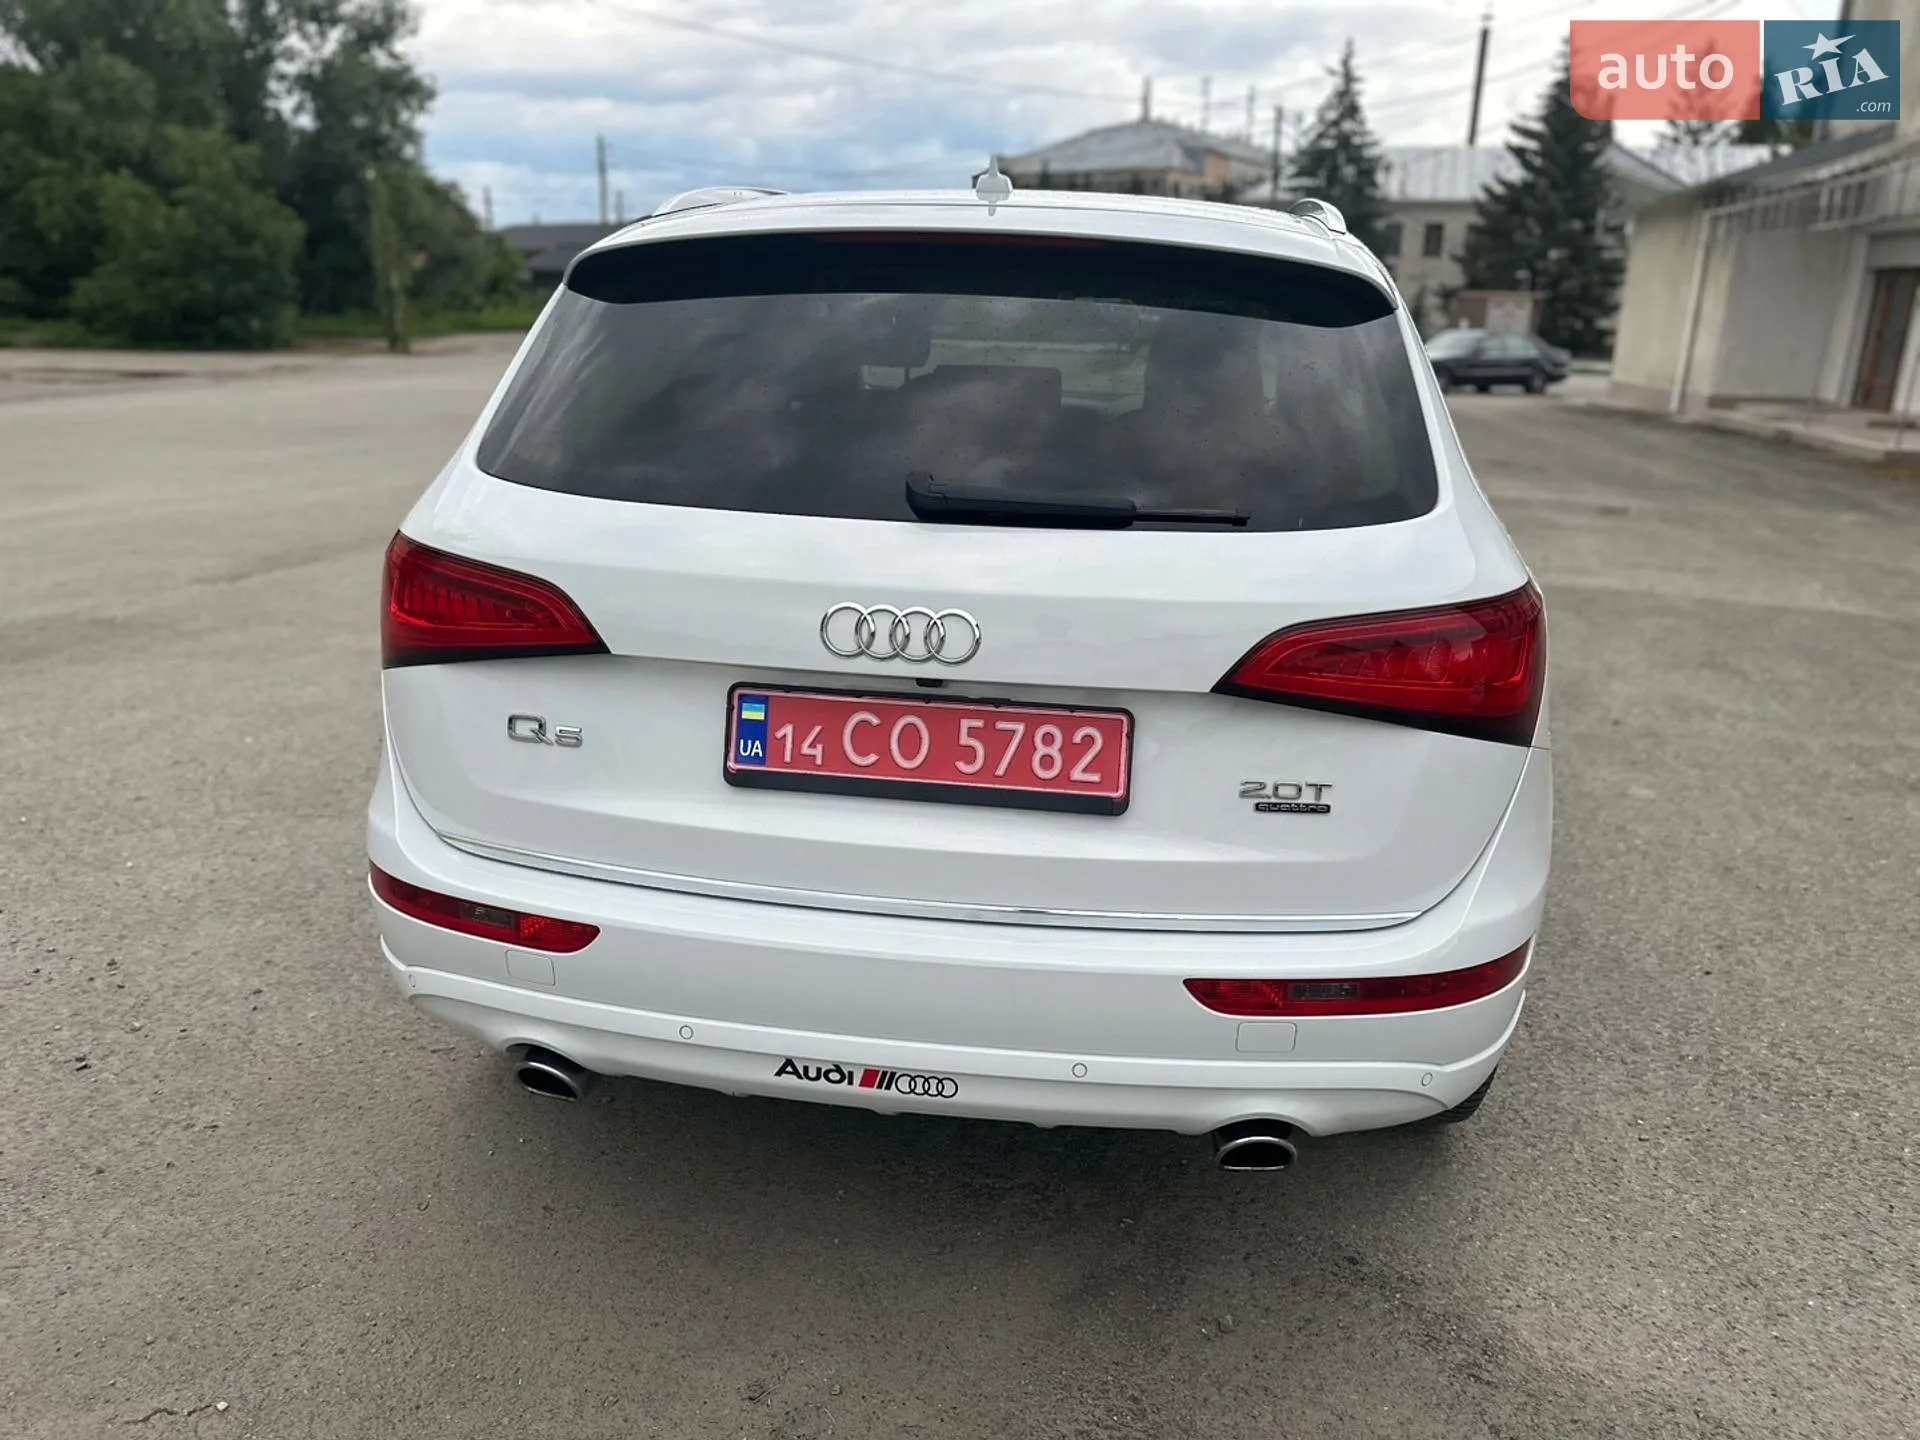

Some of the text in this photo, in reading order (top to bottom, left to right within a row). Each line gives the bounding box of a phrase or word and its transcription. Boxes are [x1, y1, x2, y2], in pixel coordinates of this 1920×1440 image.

[506, 713, 584, 749] Q5
[739, 738, 764, 758] UA
[774, 711, 1104, 783] 14 CO 5782
[1256, 802, 1330, 813] quattro
[774, 1058, 854, 1086] Audi
